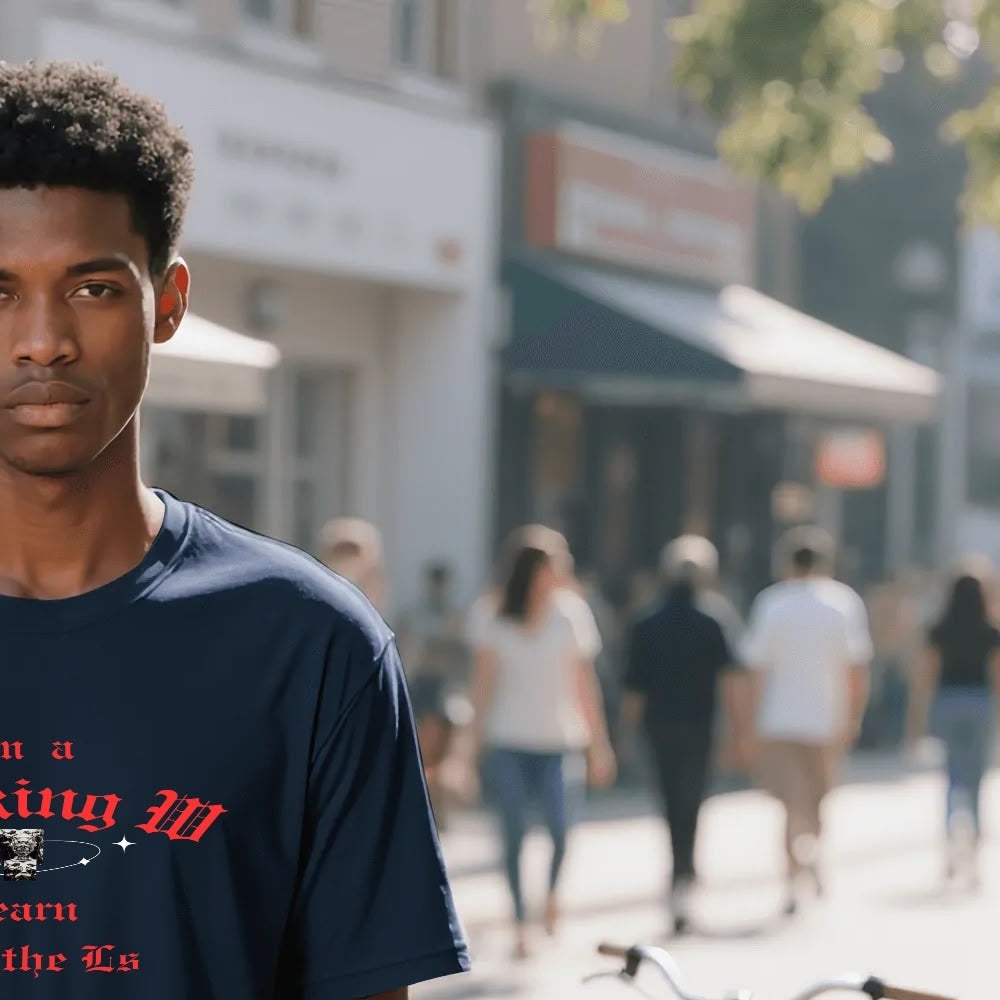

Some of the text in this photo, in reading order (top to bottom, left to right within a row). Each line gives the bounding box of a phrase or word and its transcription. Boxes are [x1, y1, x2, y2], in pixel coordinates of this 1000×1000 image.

[51, 739, 74, 760] a
[134, 789, 229, 843] W
[2, 945, 67, 978] the
[81, 945, 140, 973] Ls
